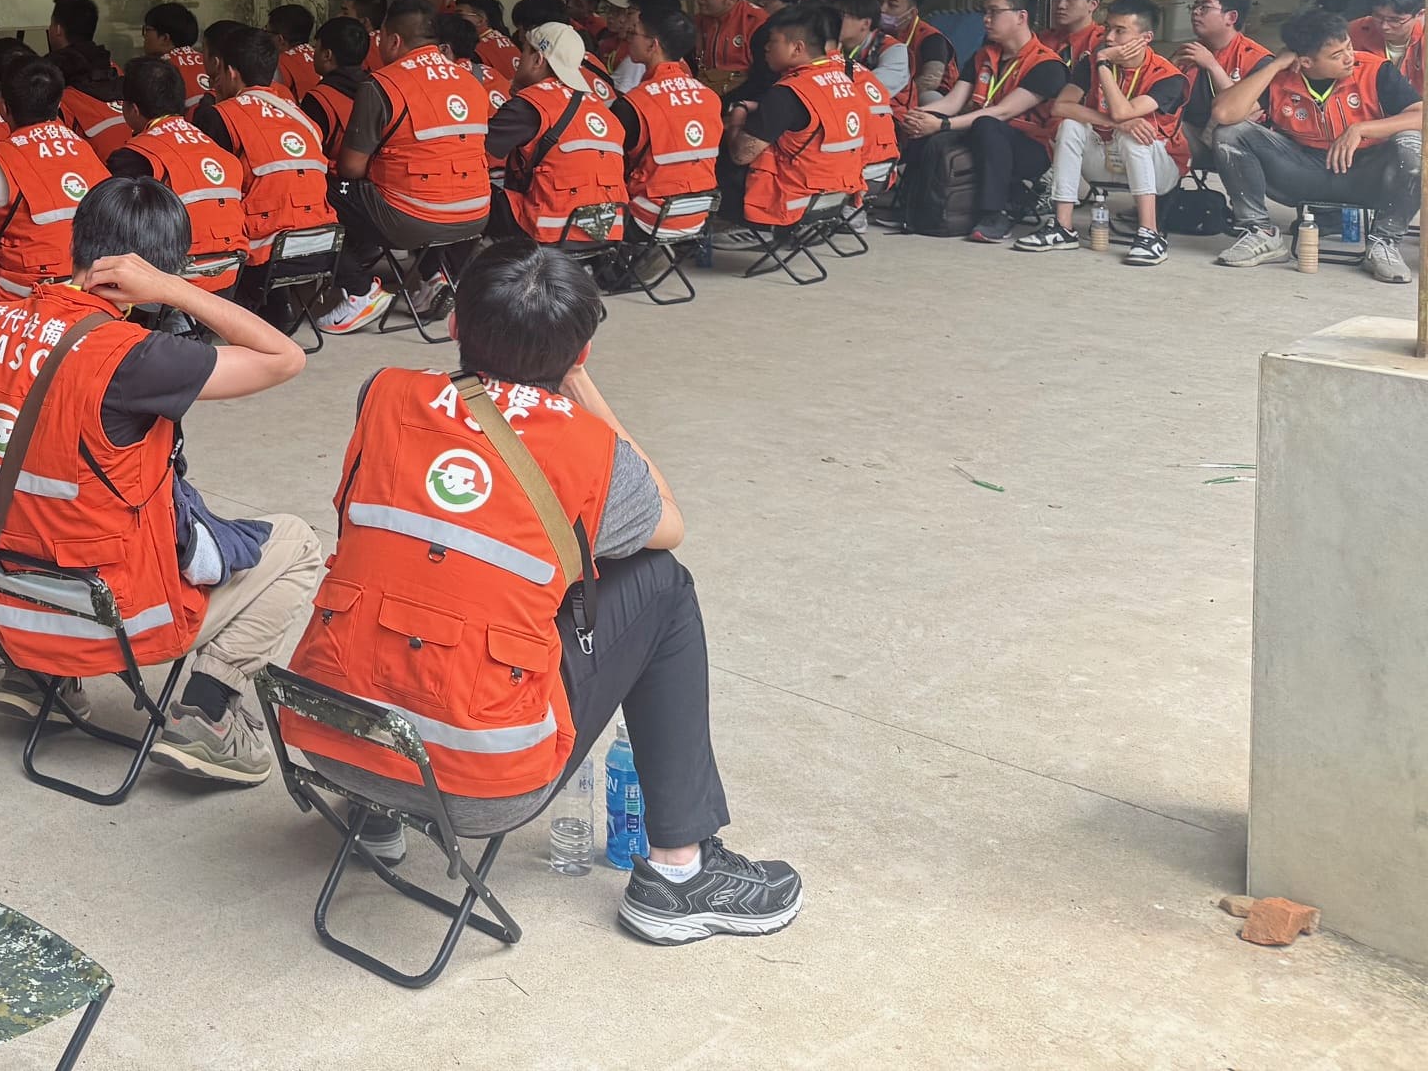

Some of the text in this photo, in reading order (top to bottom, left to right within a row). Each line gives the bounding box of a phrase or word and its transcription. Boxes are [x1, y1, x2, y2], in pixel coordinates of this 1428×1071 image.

[177, 55, 204, 66] ASC
[426, 66, 460, 81] ASC
[670, 90, 703, 106] ASC
[833, 84, 856, 99] ASC
[174, 131, 211, 144] ASC
[39, 140, 79, 158] ASC
